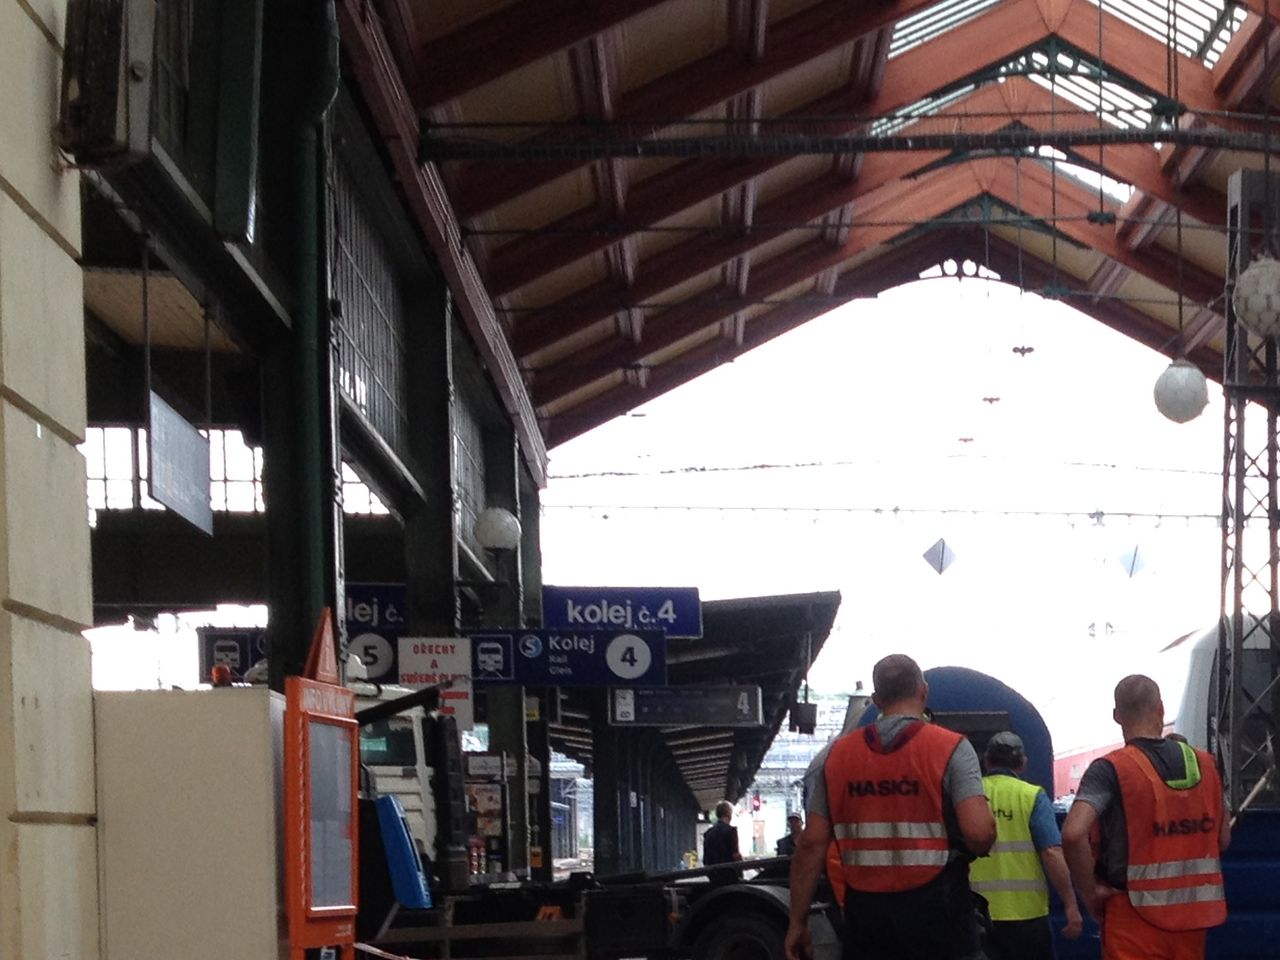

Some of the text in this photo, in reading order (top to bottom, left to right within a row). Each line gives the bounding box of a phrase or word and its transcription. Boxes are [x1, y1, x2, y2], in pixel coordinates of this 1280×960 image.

[566, 599, 633, 629] kolej
[363, 645, 379, 666] 5
[549, 635, 595, 654] Kolej
[620, 646, 638, 667] 4
